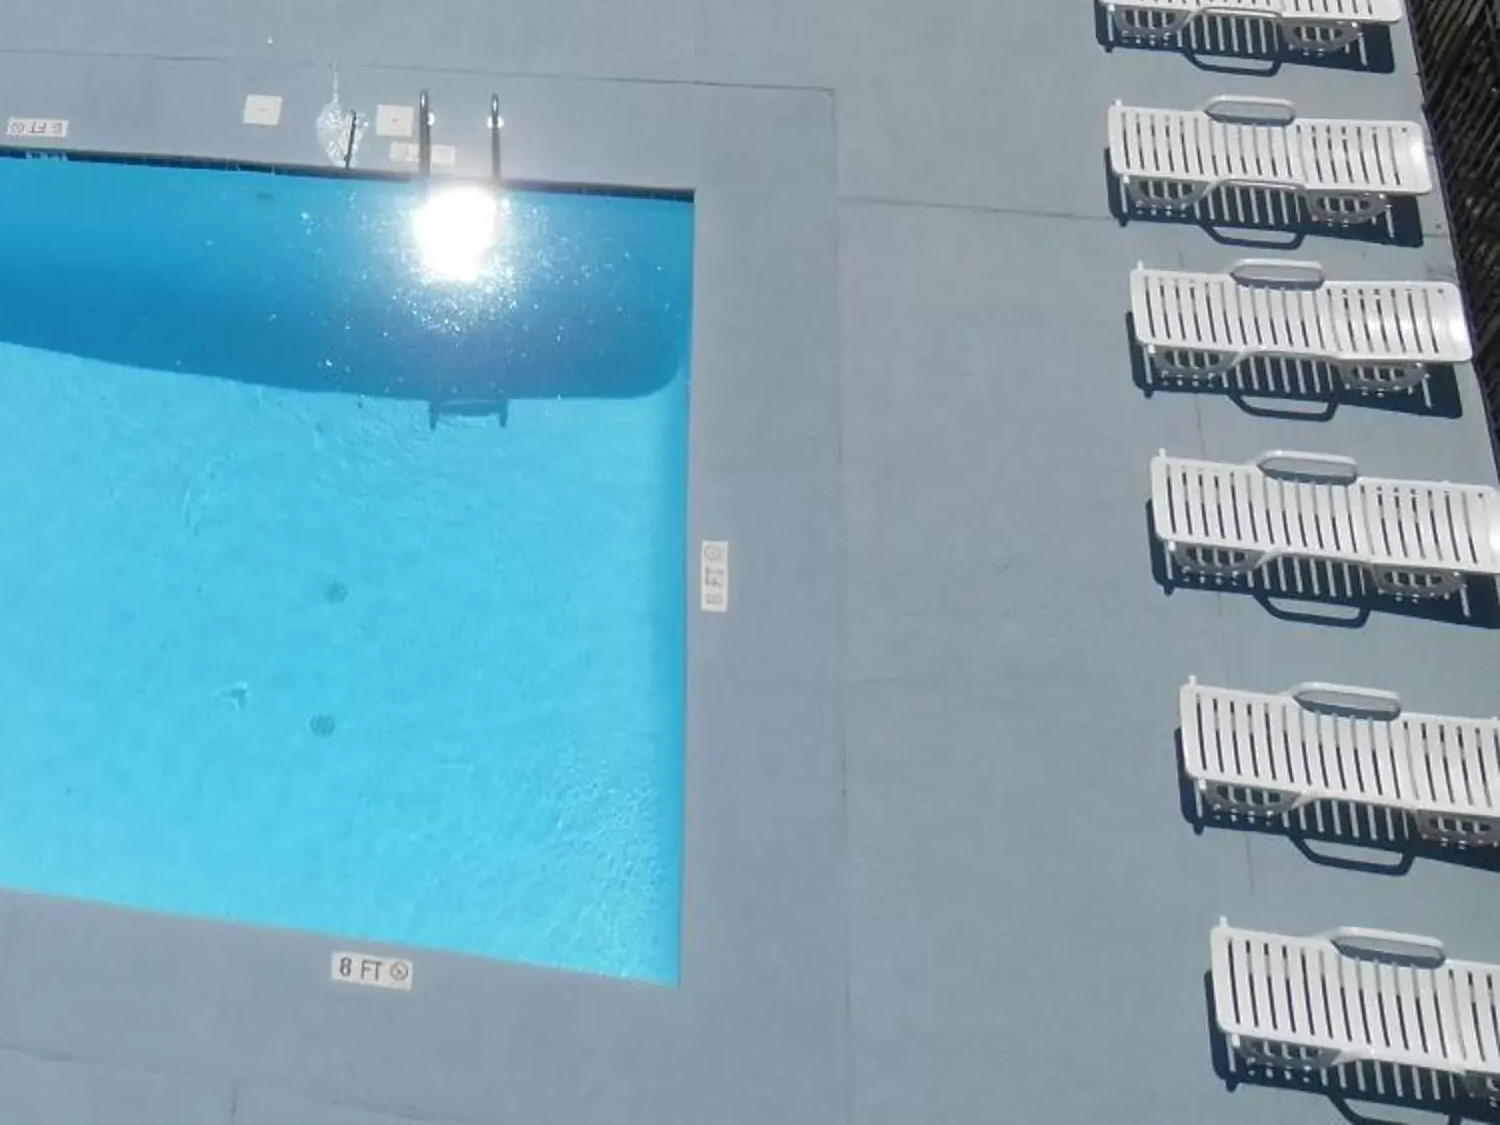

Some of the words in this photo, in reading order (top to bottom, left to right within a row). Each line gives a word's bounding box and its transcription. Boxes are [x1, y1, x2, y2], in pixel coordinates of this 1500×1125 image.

[29, 121, 48, 134] FT
[705, 566, 725, 588] FT
[339, 956, 352, 977] 8
[361, 959, 383, 982] FT
